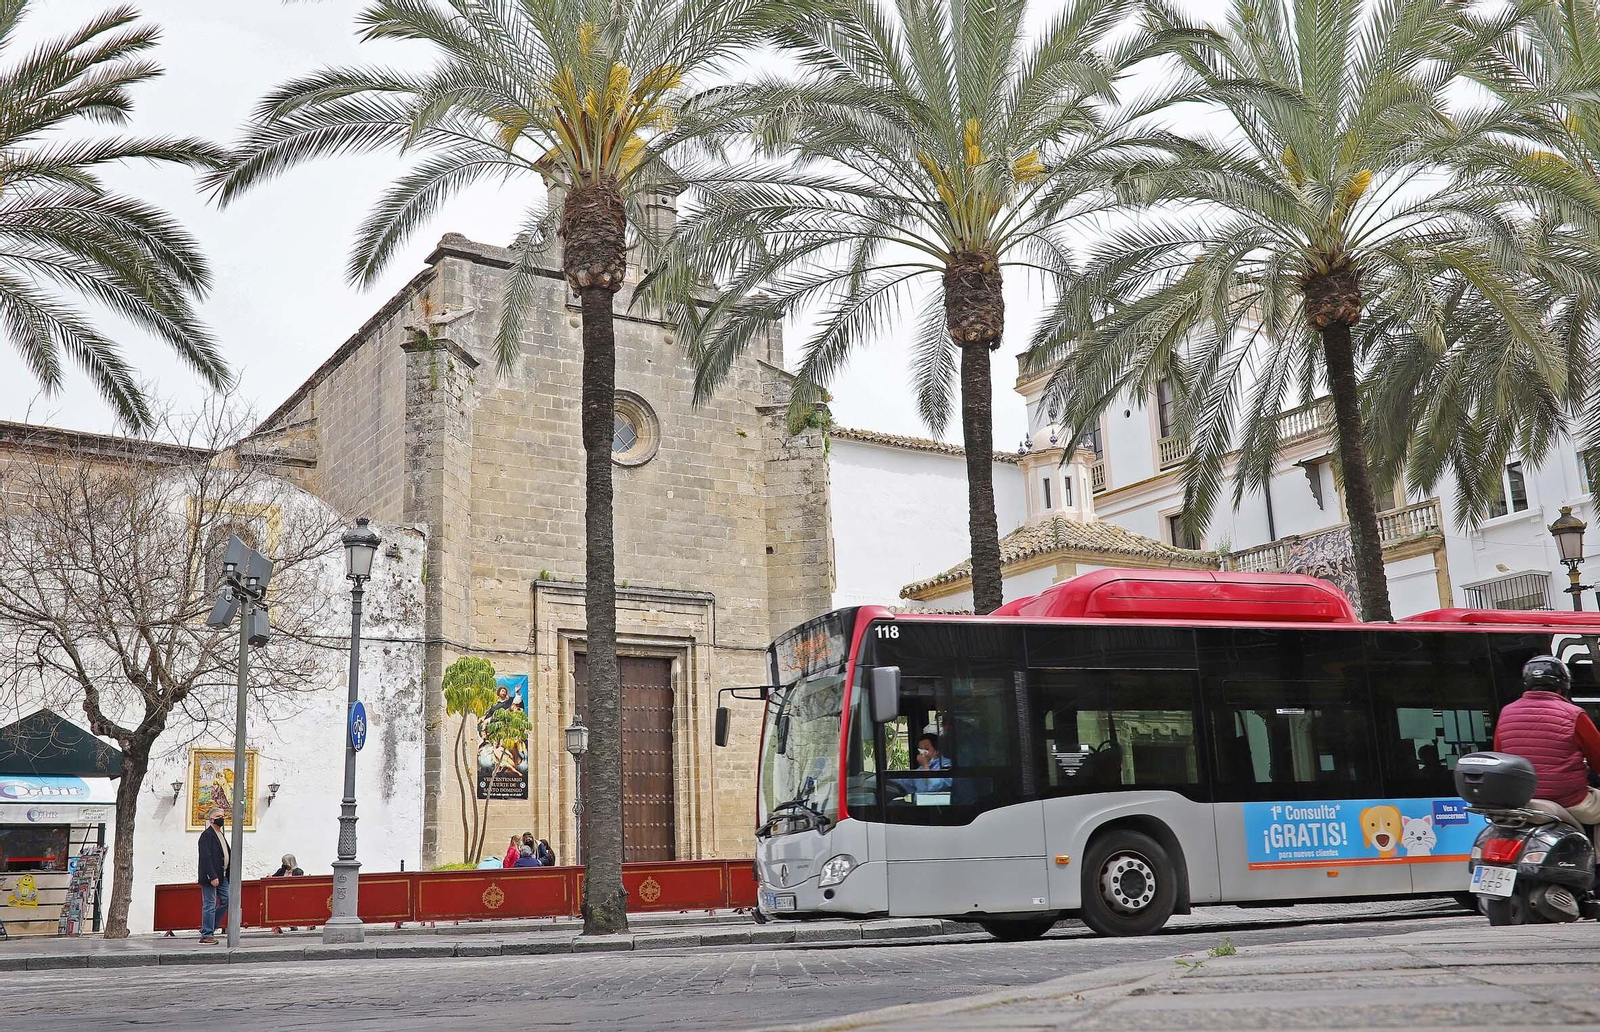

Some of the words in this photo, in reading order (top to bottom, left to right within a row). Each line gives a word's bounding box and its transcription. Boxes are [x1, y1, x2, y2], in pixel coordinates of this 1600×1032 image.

[875, 625, 900, 639] 118
[0, 780, 83, 799] Orbit
[1436, 812, 1467, 820] conocernos!
[1263, 822, 1348, 854] ¡GRATIS!
[1279, 851, 1293, 860] para
[1293, 850, 1315, 858] nuevos
[1315, 849, 1339, 857] clientes
